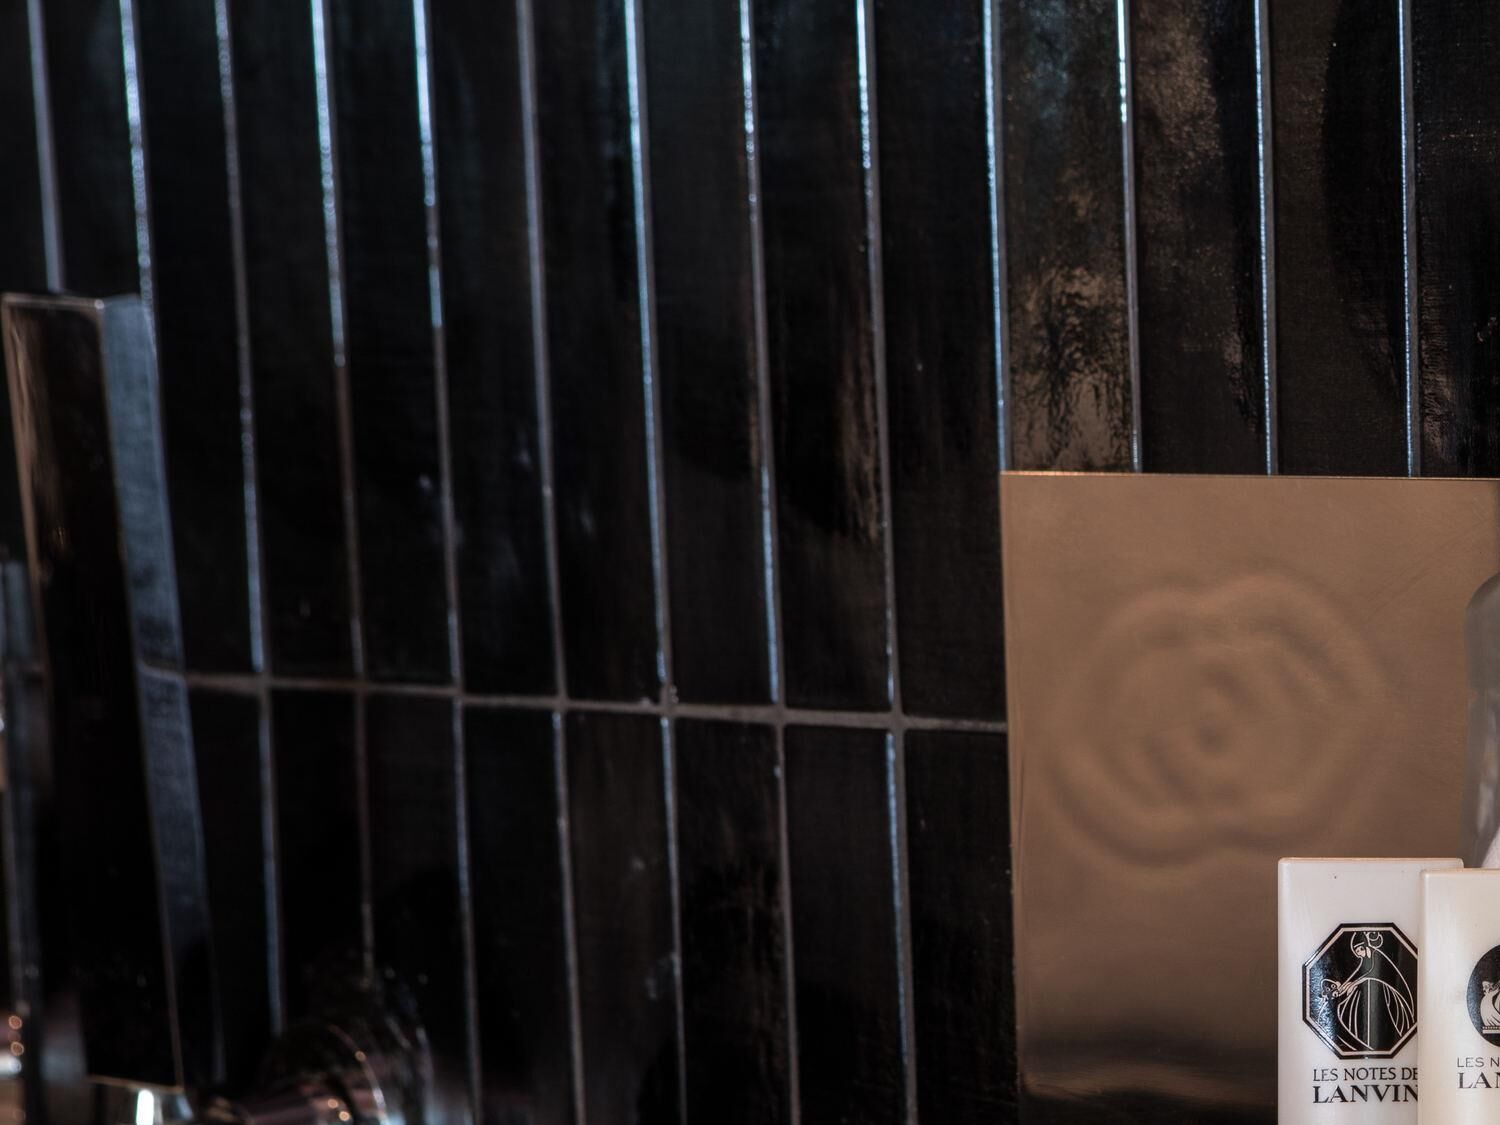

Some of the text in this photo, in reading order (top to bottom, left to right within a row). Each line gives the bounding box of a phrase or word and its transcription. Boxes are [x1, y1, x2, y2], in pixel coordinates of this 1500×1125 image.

[1456, 1057, 1484, 1068] LES
[1312, 1068, 1338, 1082] LES
[1344, 1067, 1396, 1081] NOTES
[1312, 1084, 1418, 1104] LANVIN
